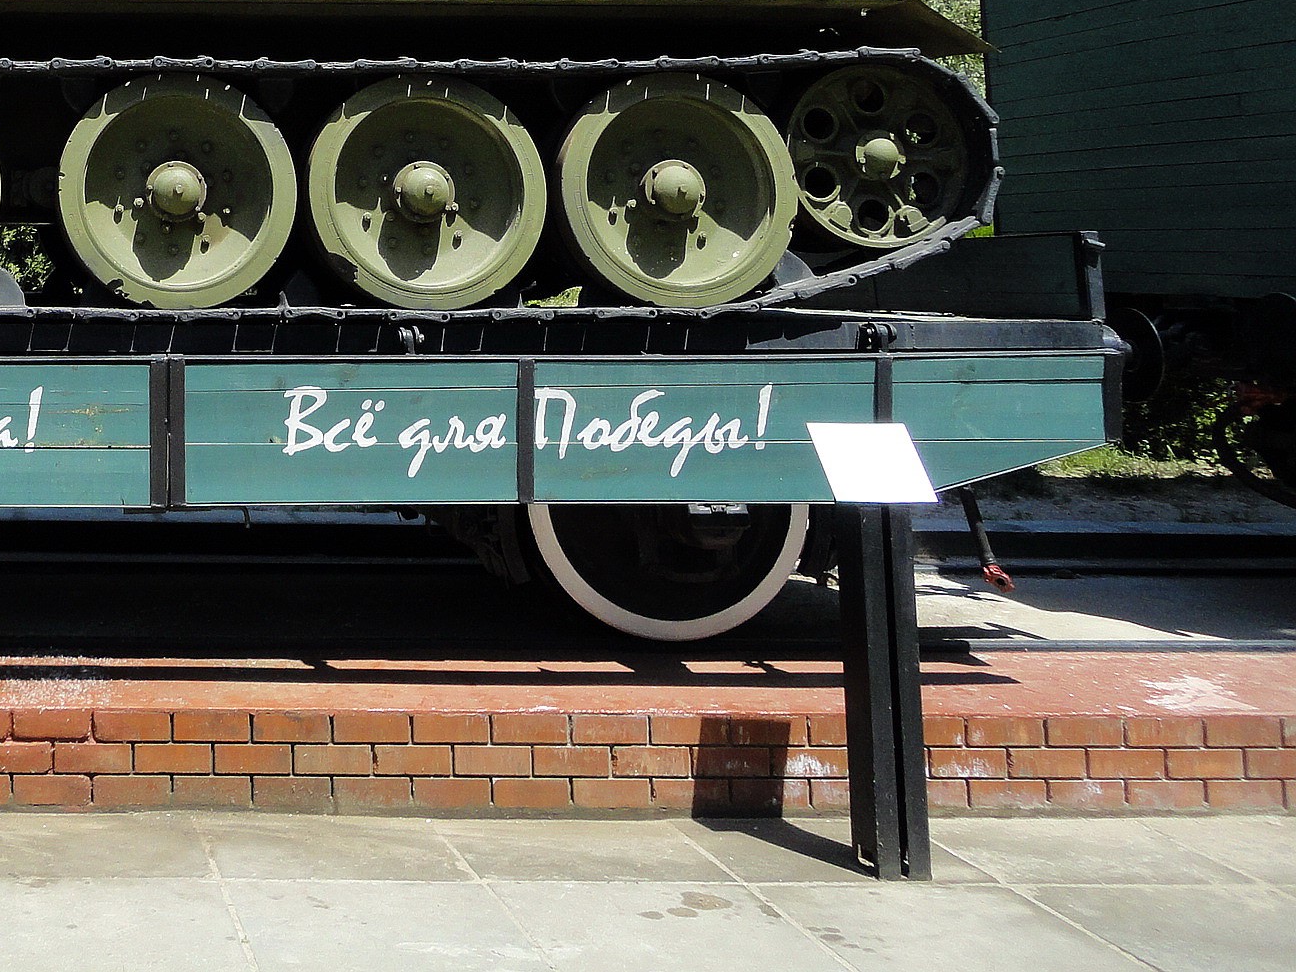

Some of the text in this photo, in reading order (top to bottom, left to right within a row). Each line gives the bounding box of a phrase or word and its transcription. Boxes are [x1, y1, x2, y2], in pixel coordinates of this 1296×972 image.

[282, 382, 774, 478] Всё для Победы!
